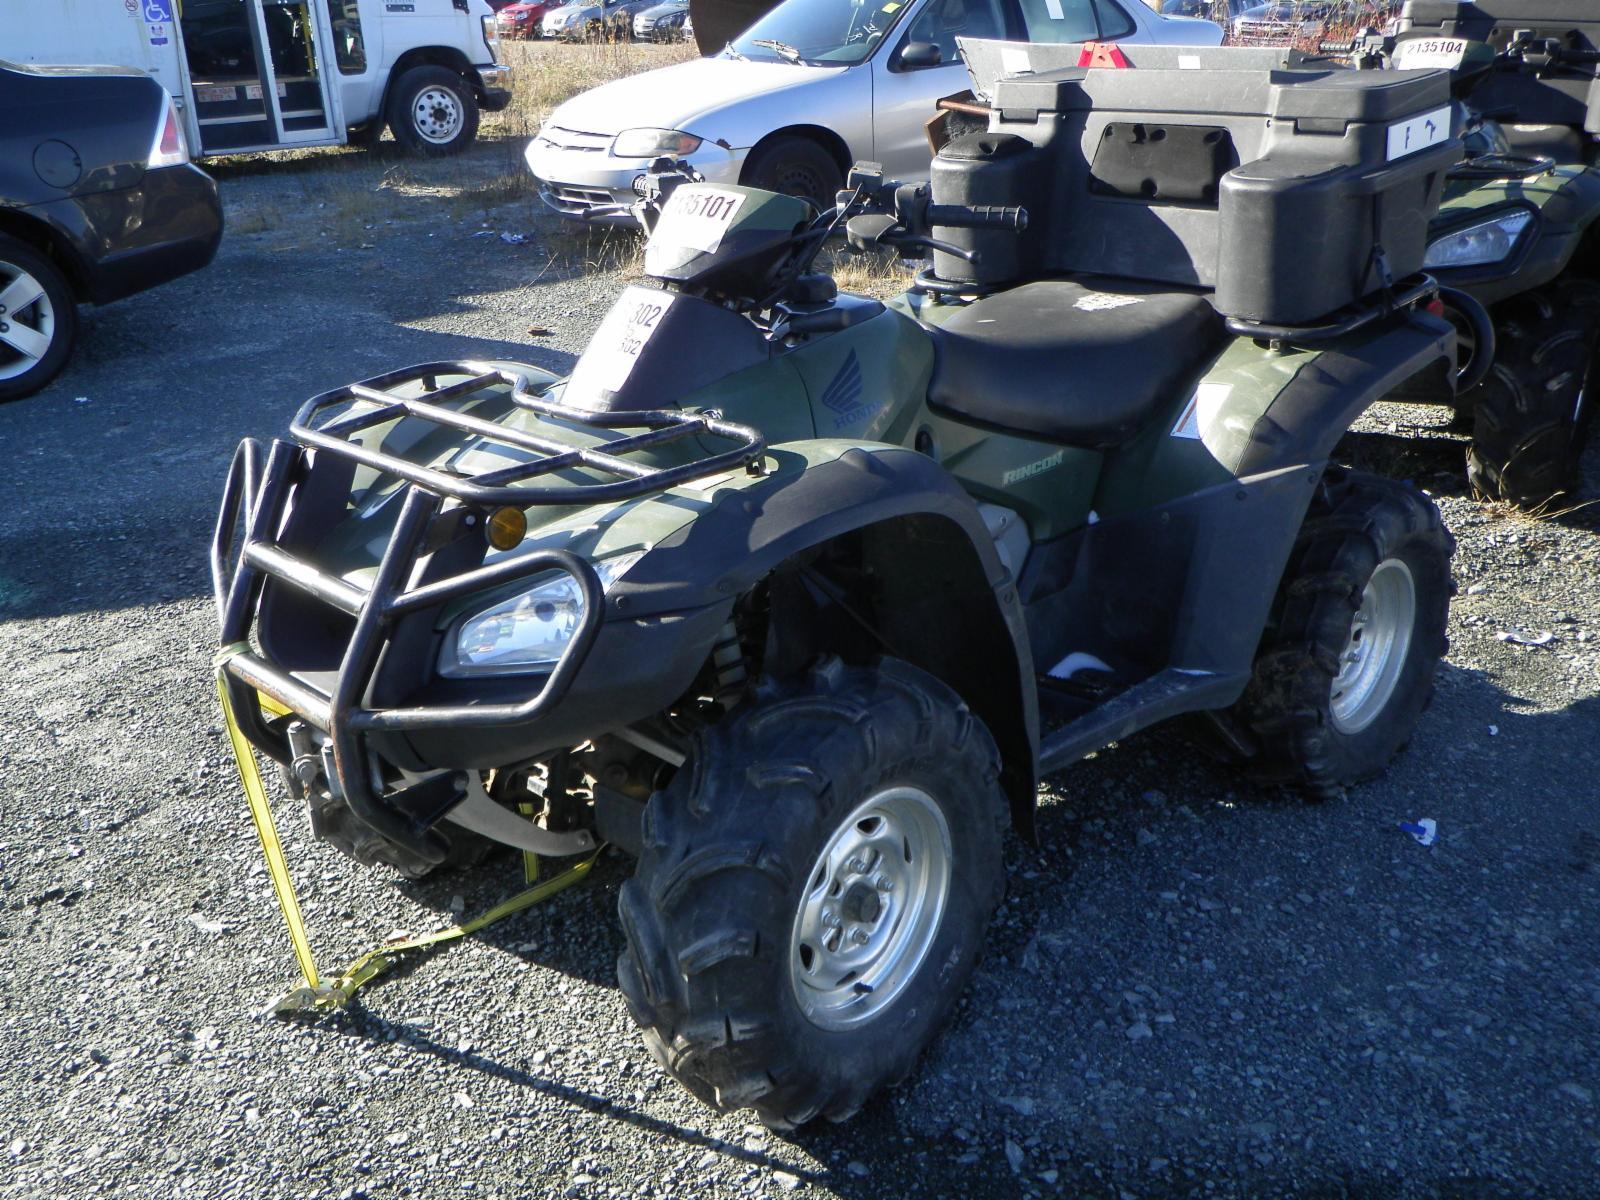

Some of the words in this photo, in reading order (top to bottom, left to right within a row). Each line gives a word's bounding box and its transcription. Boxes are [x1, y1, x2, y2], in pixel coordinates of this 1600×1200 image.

[1408, 41, 1463, 54] 2135104
[675, 193, 737, 221] 35101
[1002, 449, 1064, 486] RINCON
